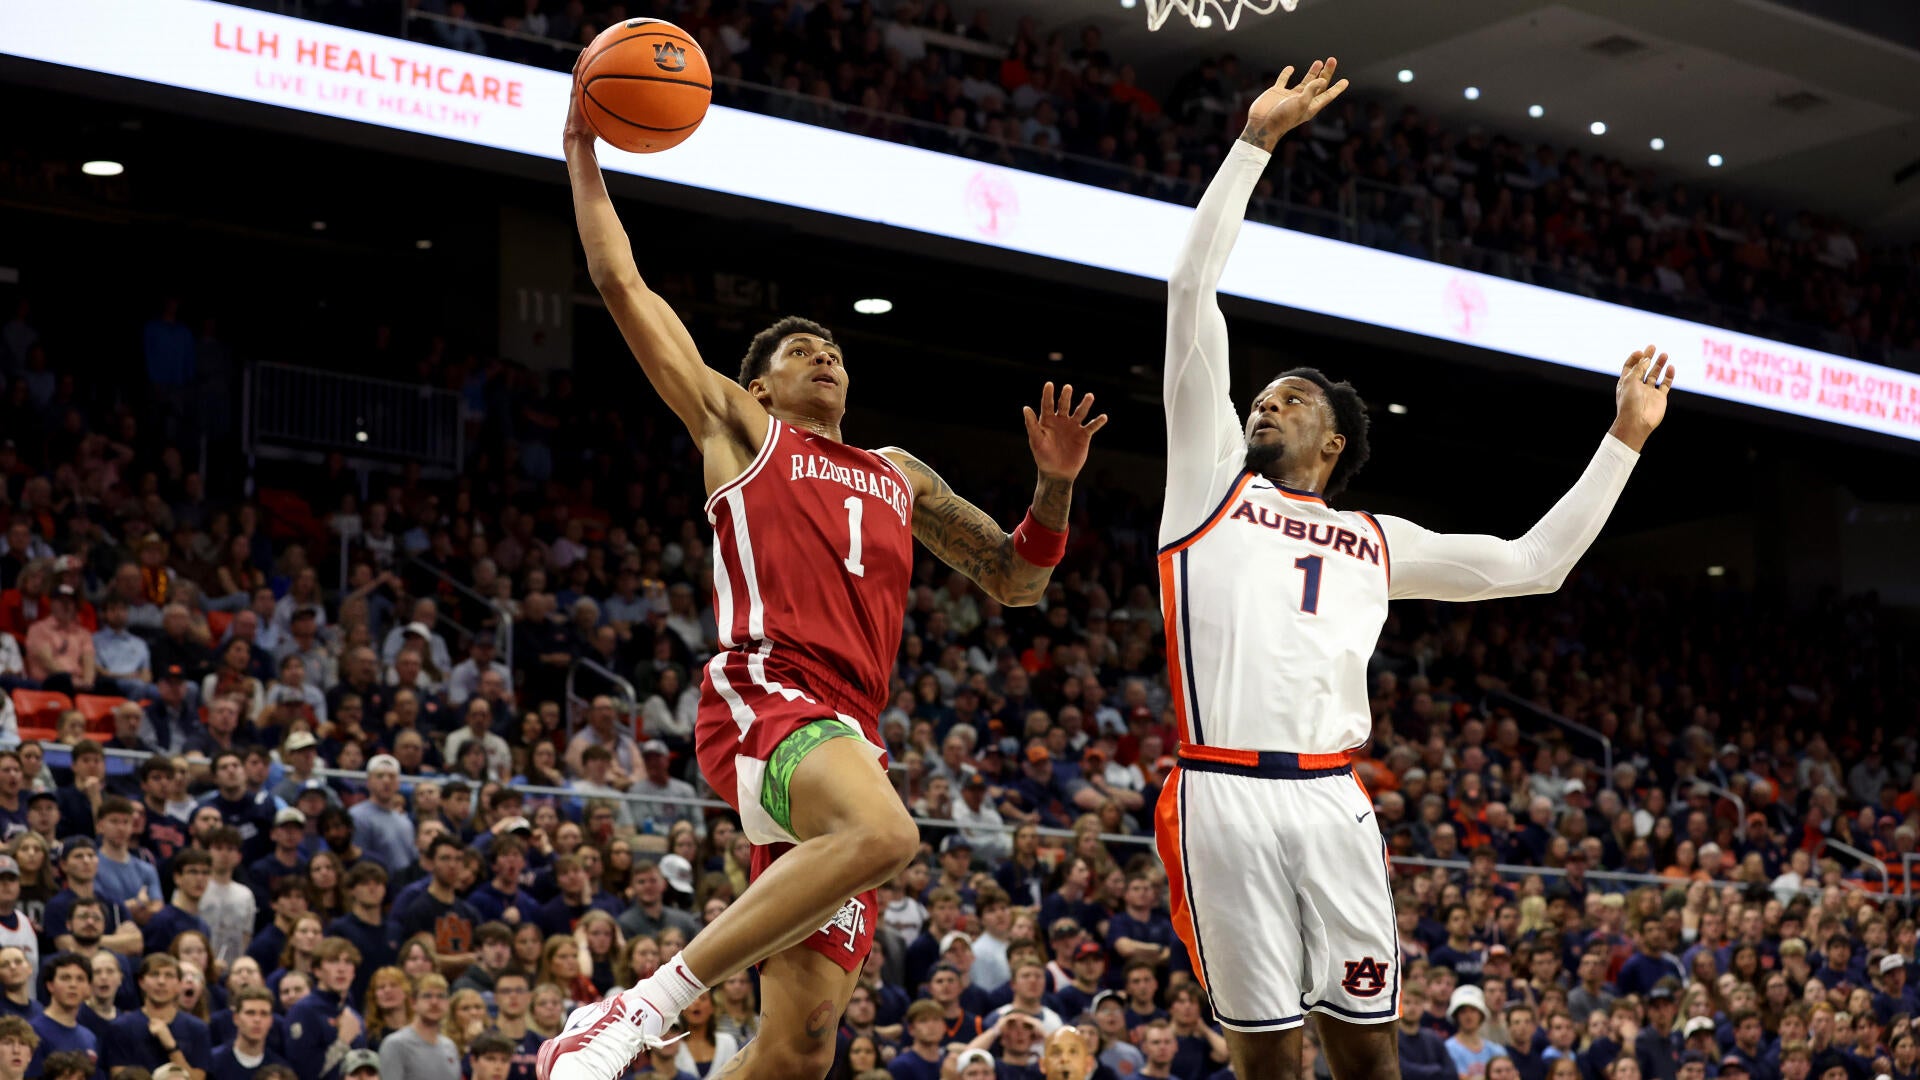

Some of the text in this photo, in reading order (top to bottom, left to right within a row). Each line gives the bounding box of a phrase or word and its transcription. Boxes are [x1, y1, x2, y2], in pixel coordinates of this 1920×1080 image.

[214, 20, 523, 107] LLH HEALTHCARE
[255, 70, 482, 128] LIVE LIFE HEALTHY
[1703, 337, 1732, 362] THE
[1740, 346, 1813, 380] OFFICIAL
[1821, 365, 1903, 402] EMPLOYEE
[1705, 362, 1783, 396] PARTNER
[1791, 382, 1810, 401] OF
[1817, 388, 1887, 418] AUBURN
[790, 453, 909, 527] RAZORBACKS
[843, 495, 865, 578] 1
[1230, 499, 1380, 567] AUBURN
[1293, 553, 1325, 616] 1
